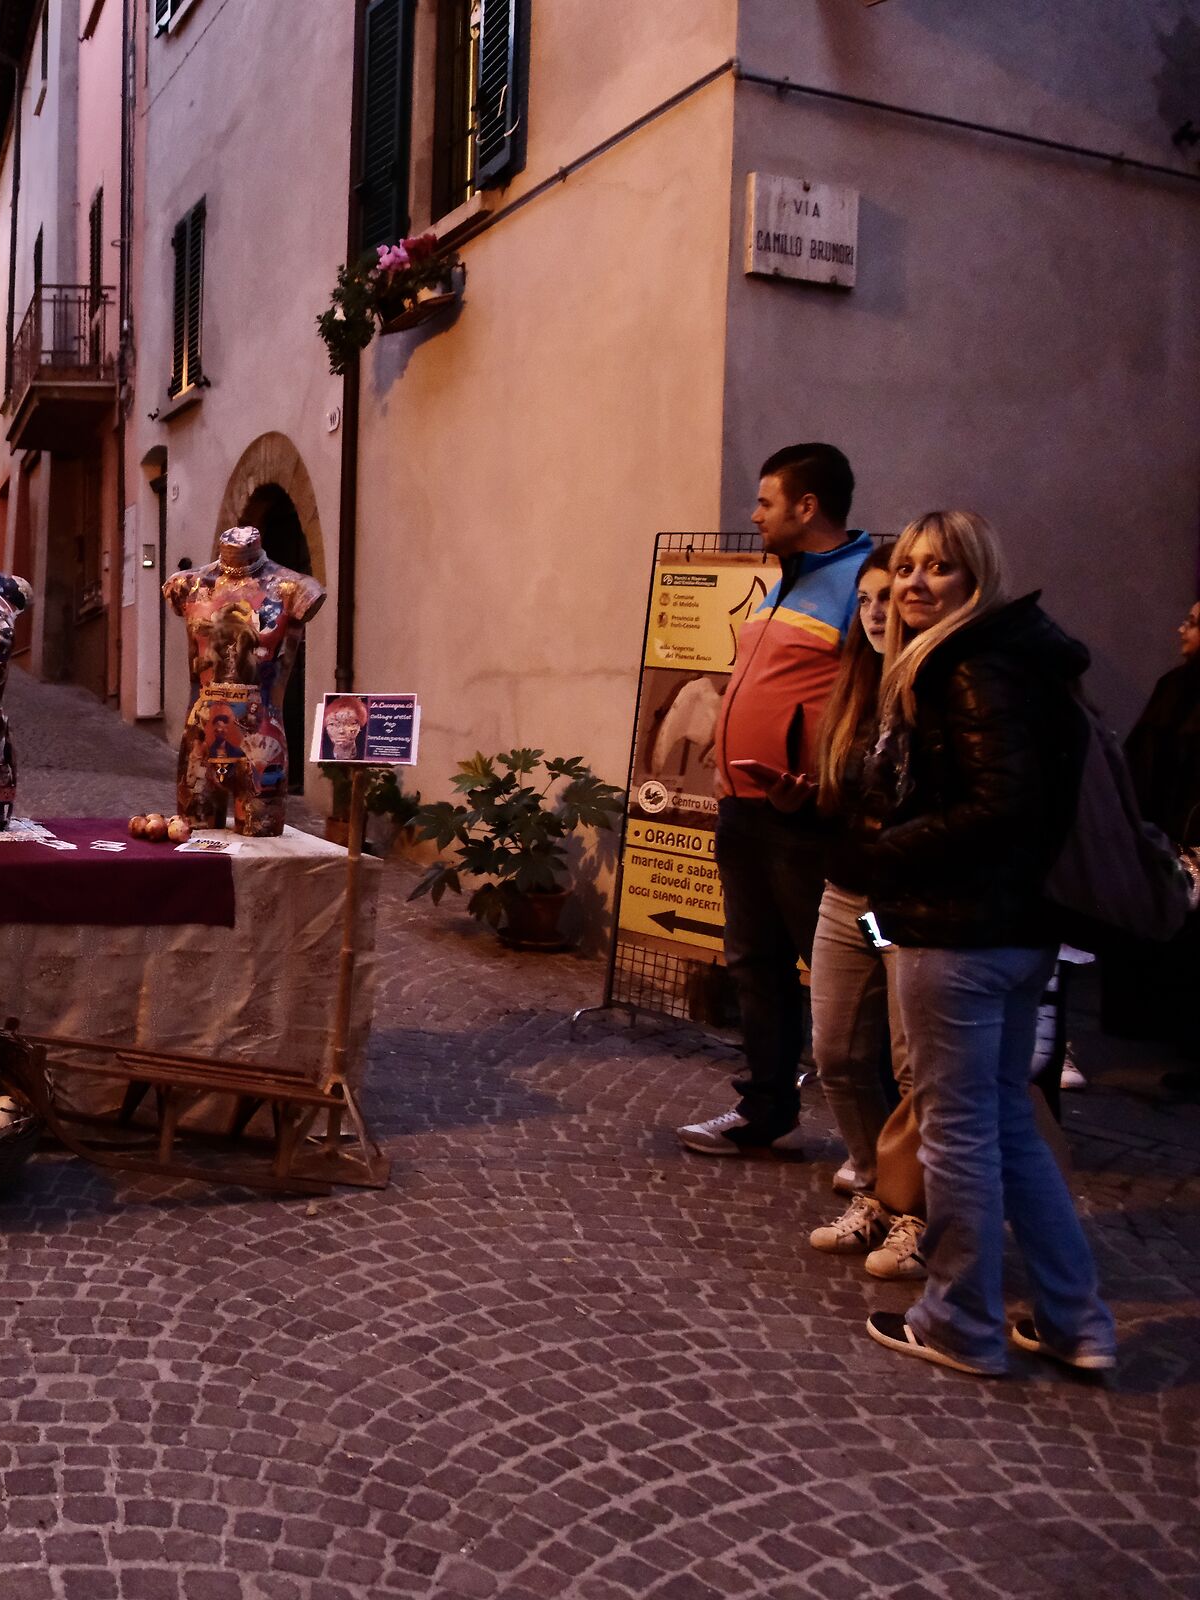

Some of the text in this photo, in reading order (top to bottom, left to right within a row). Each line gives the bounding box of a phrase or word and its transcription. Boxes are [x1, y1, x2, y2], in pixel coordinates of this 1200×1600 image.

[793, 200, 821, 218] VIA
[756, 230, 854, 266] CAMILLO BRUNORI
[671, 795, 701, 809] Centro
[644, 828, 702, 851] ORARIO
[676, 864, 684, 873] e
[694, 881, 714, 895] ore
[628, 884, 721, 912] OGGI SIAMO APERTI
